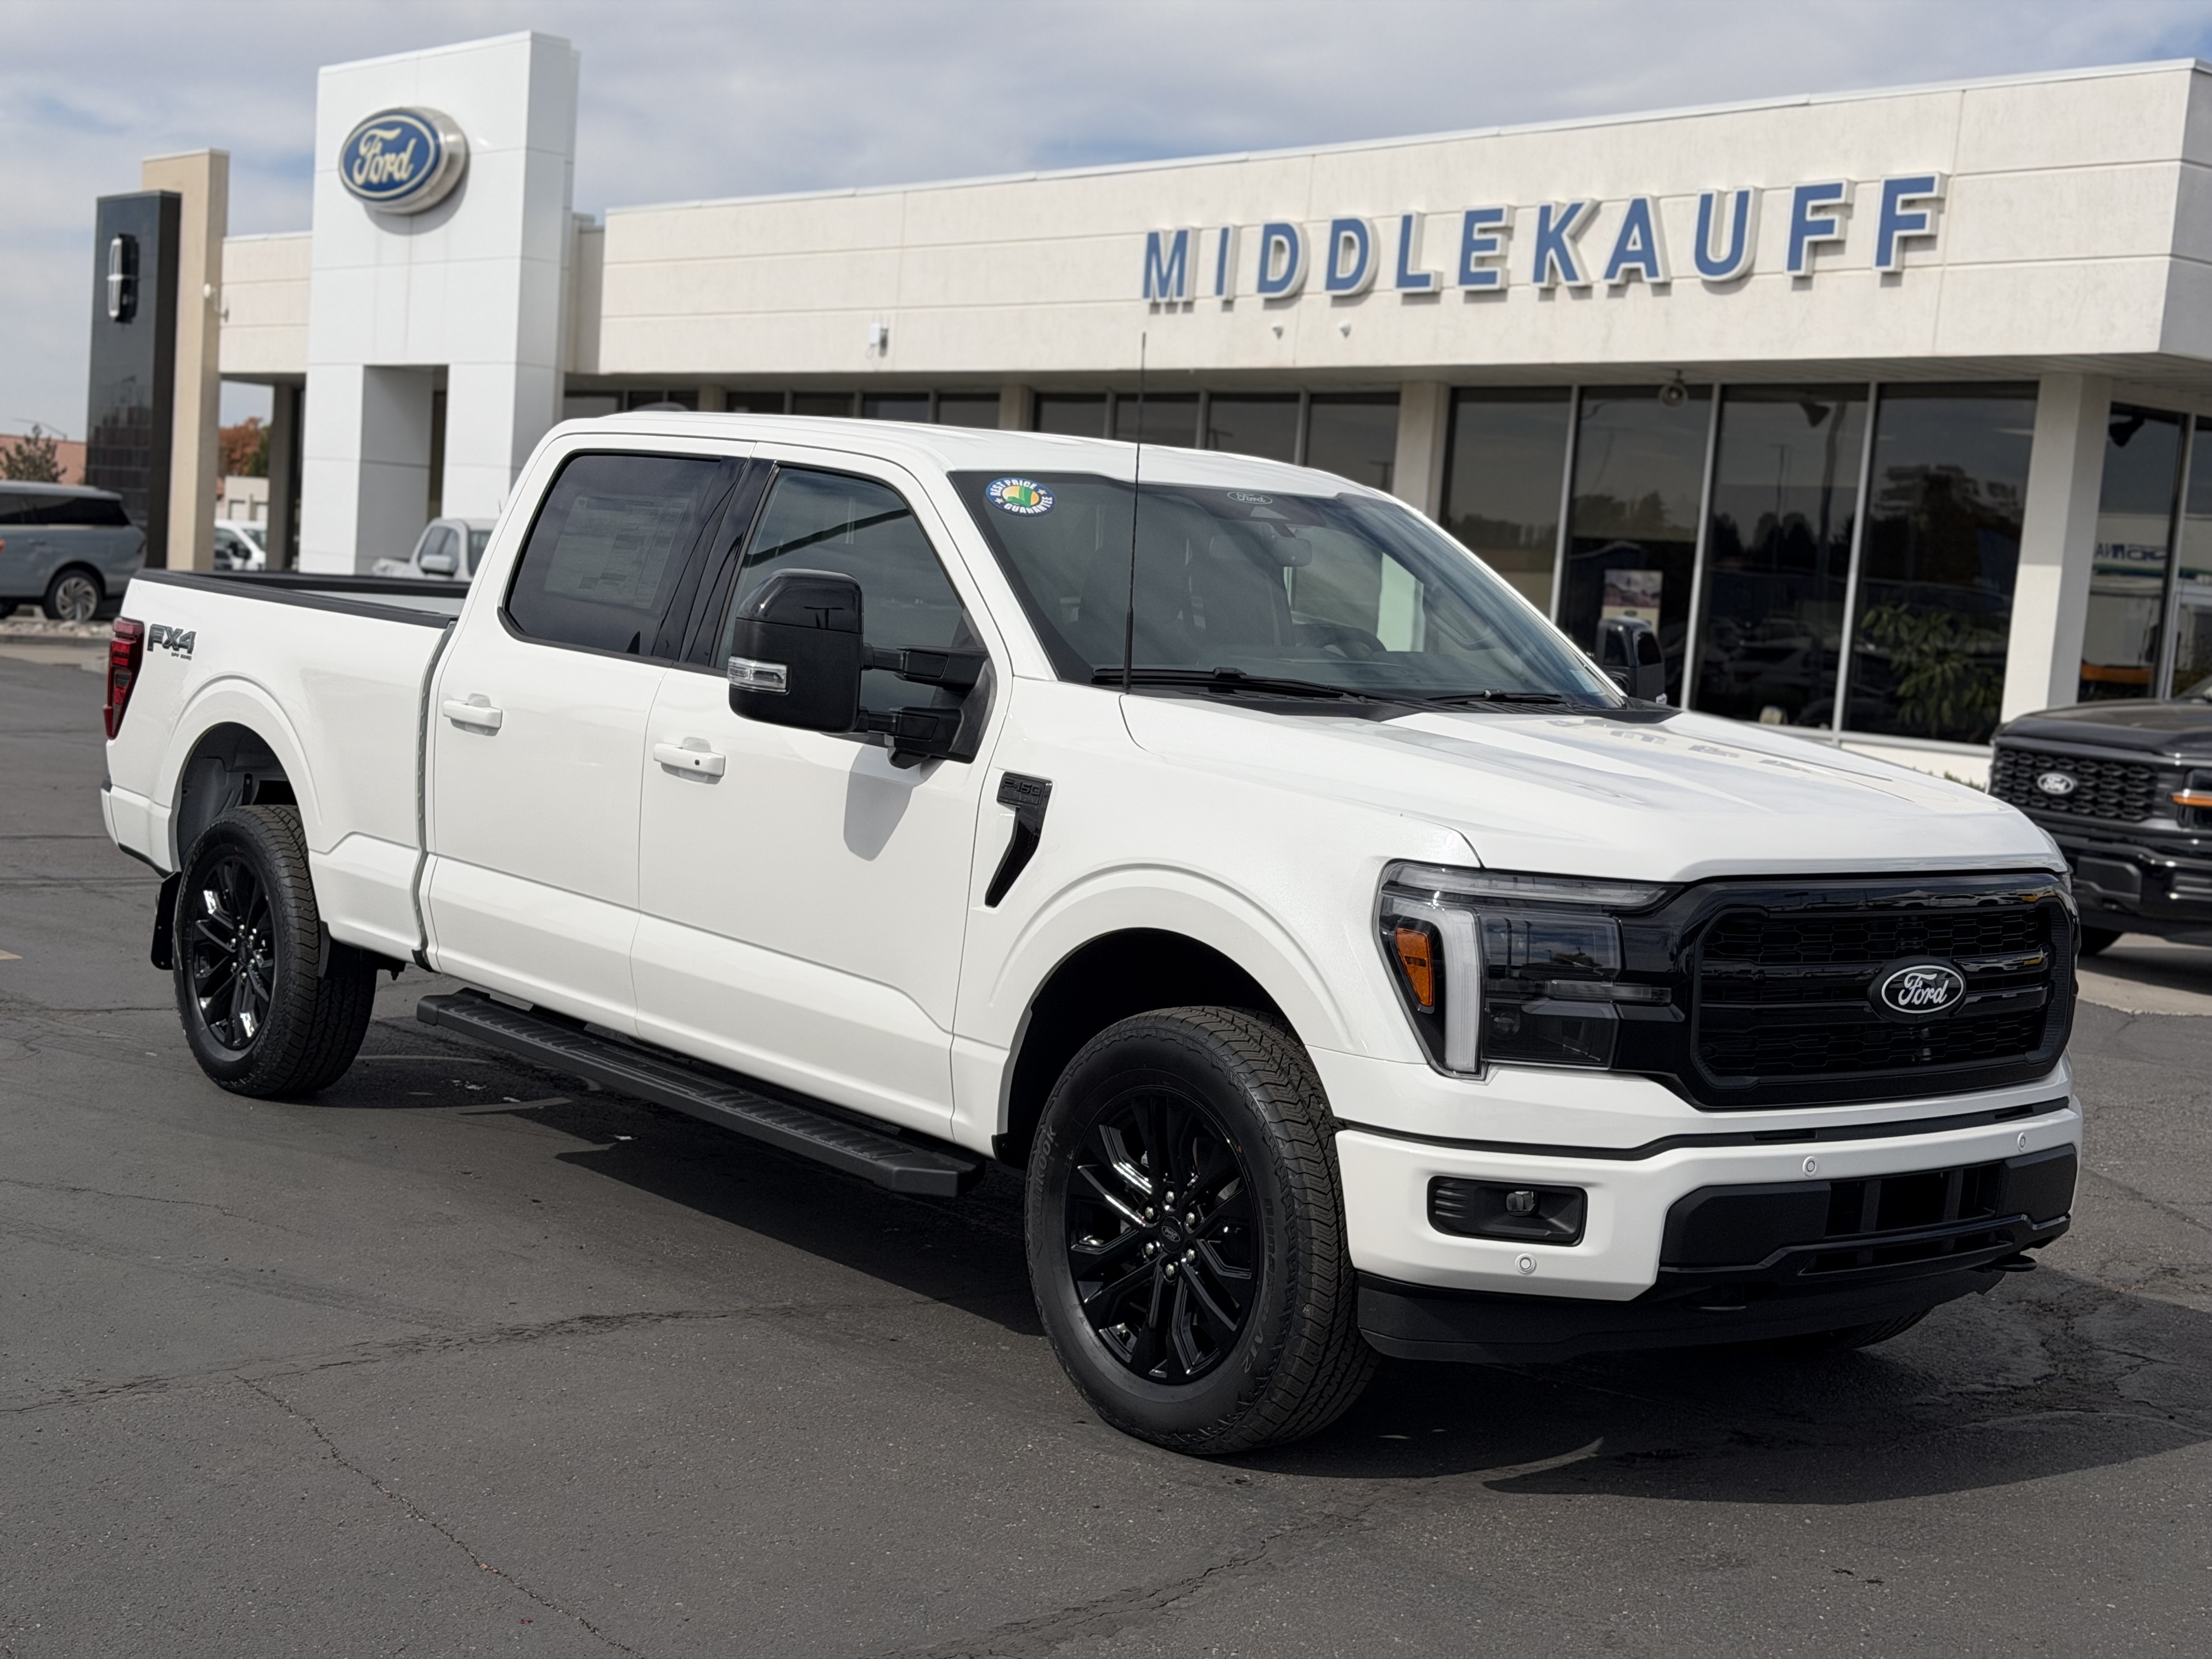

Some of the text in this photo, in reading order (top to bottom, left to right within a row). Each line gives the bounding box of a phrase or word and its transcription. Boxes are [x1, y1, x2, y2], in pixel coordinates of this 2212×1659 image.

[353, 127, 417, 185] Ford
[1142, 173, 1945, 303] MIDDLEKAUFF
[990, 479, 1038, 496] BEST PRICE
[1236, 493, 1266, 503] Ford
[1003, 496, 1053, 514] GUARANTEE
[146, 623, 197, 654] FX4
[1001, 778, 1043, 797] F-150
[1898, 973, 1949, 1006] Ford
